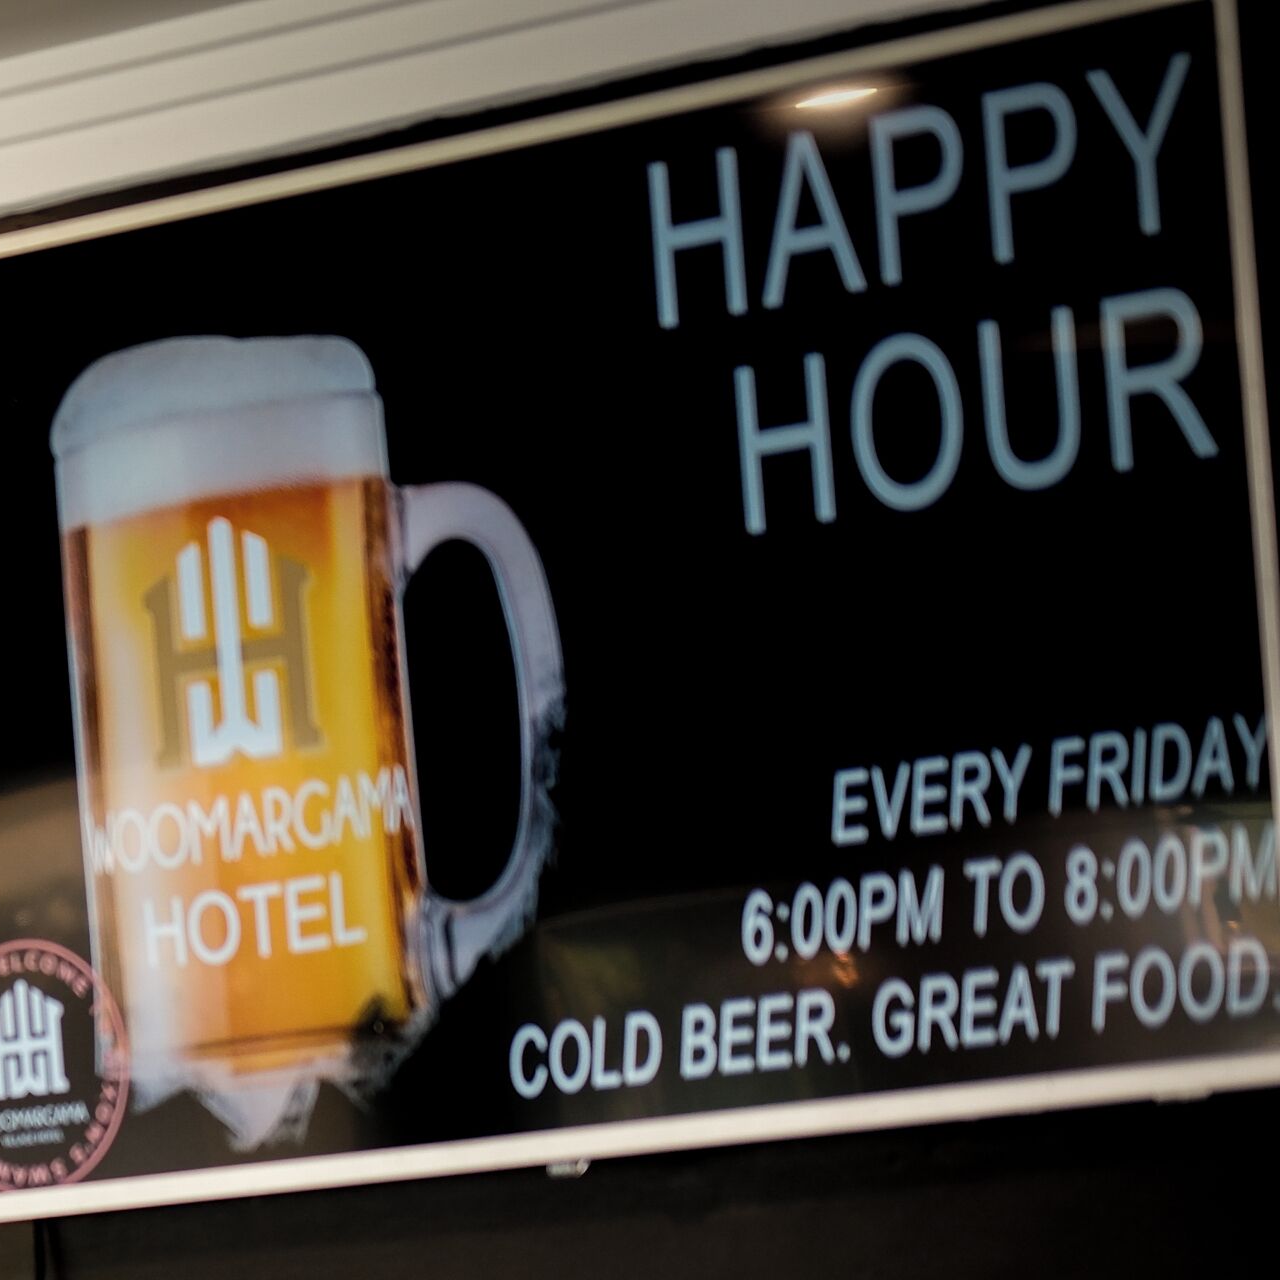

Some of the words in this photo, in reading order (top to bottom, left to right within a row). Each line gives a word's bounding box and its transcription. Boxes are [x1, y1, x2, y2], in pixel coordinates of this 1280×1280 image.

[647, 52, 1190, 328] HAPPY
[734, 287, 1219, 535] HOUR
[87, 765, 416, 875] WOOMARGAMA
[832, 744, 1031, 846] EVERY
[1048, 714, 1267, 816] FRIDAY
[143, 871, 367, 969] HOTEL
[741, 866, 944, 965] 6:00PM
[964, 853, 1042, 935] TO
[1065, 819, 1278, 926] 8:00PM
[510, 1010, 662, 1099] COLD
[680, 990, 850, 1081] BEER.
[872, 960, 1074, 1058] GREAT
